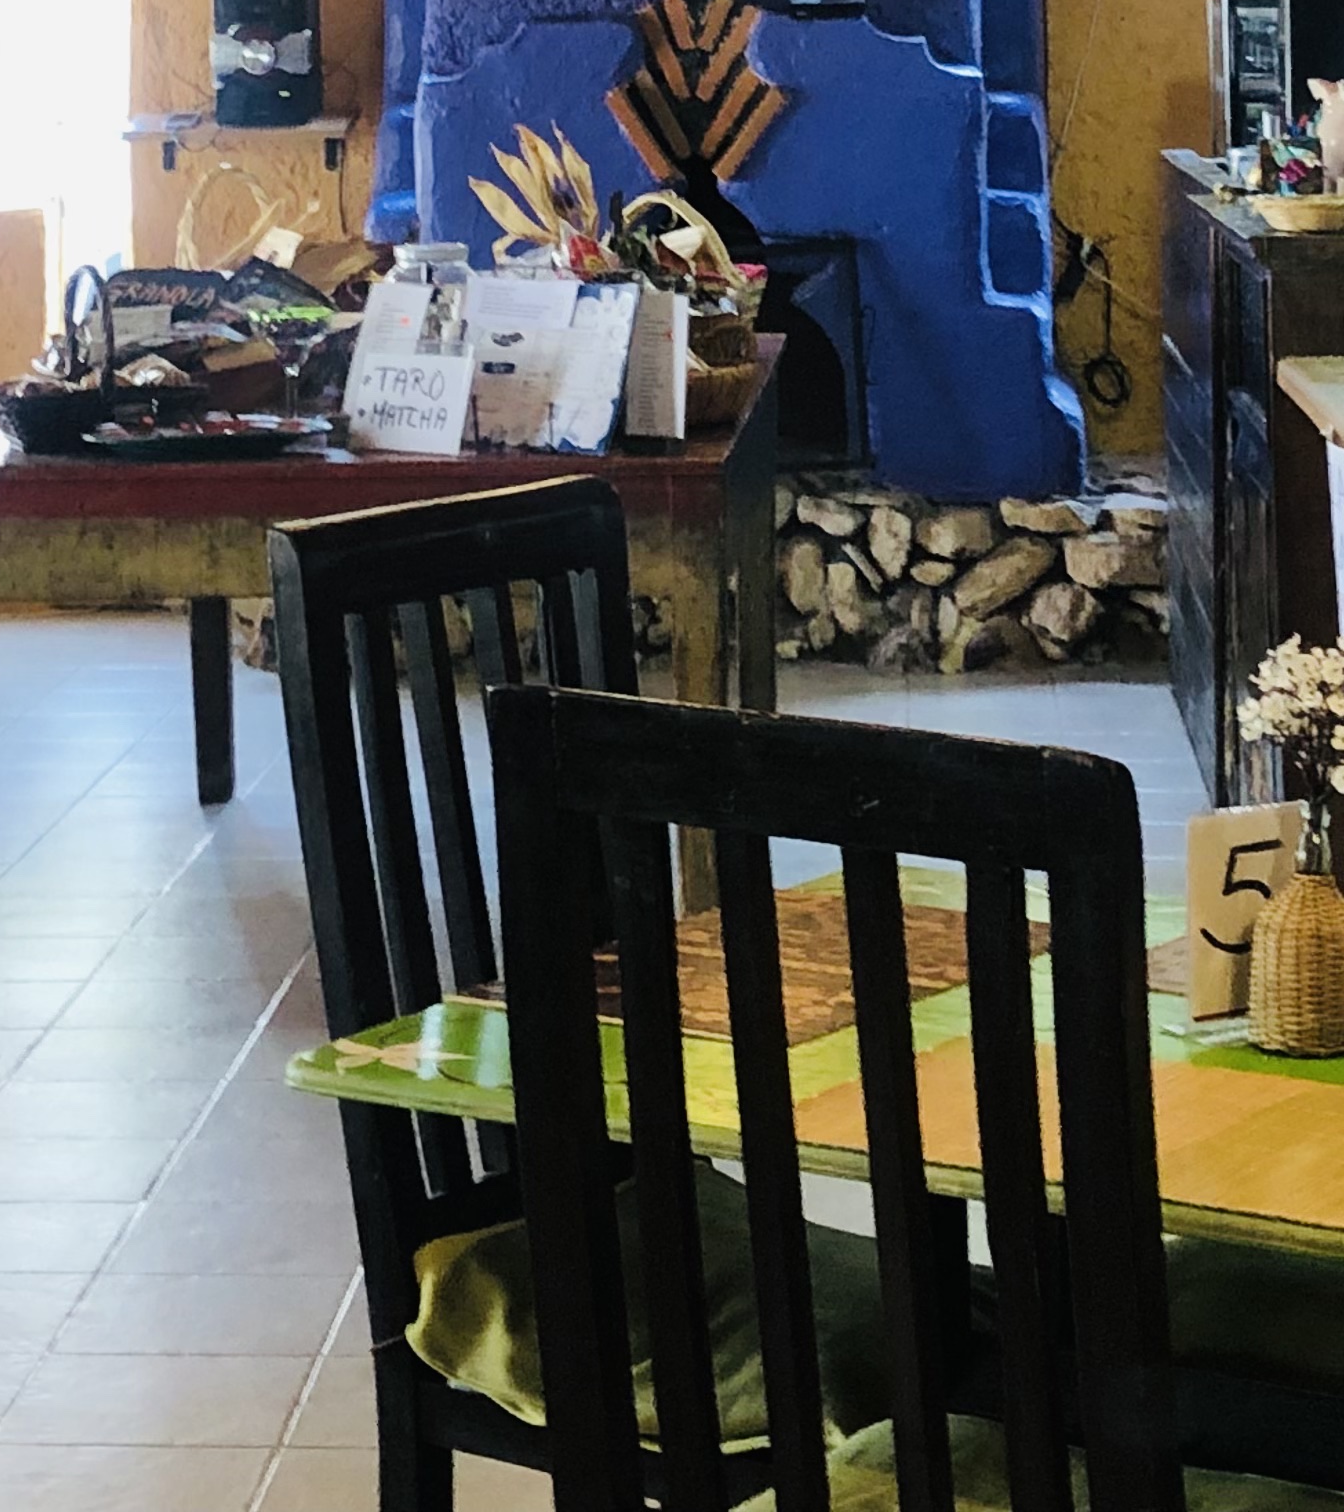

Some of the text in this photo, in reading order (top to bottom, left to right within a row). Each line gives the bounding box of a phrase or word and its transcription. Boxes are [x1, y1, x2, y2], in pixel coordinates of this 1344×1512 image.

[374, 366, 445, 400] TARO
[372, 401, 448, 431] MATCHA
[1200, 839, 1283, 954] 5
